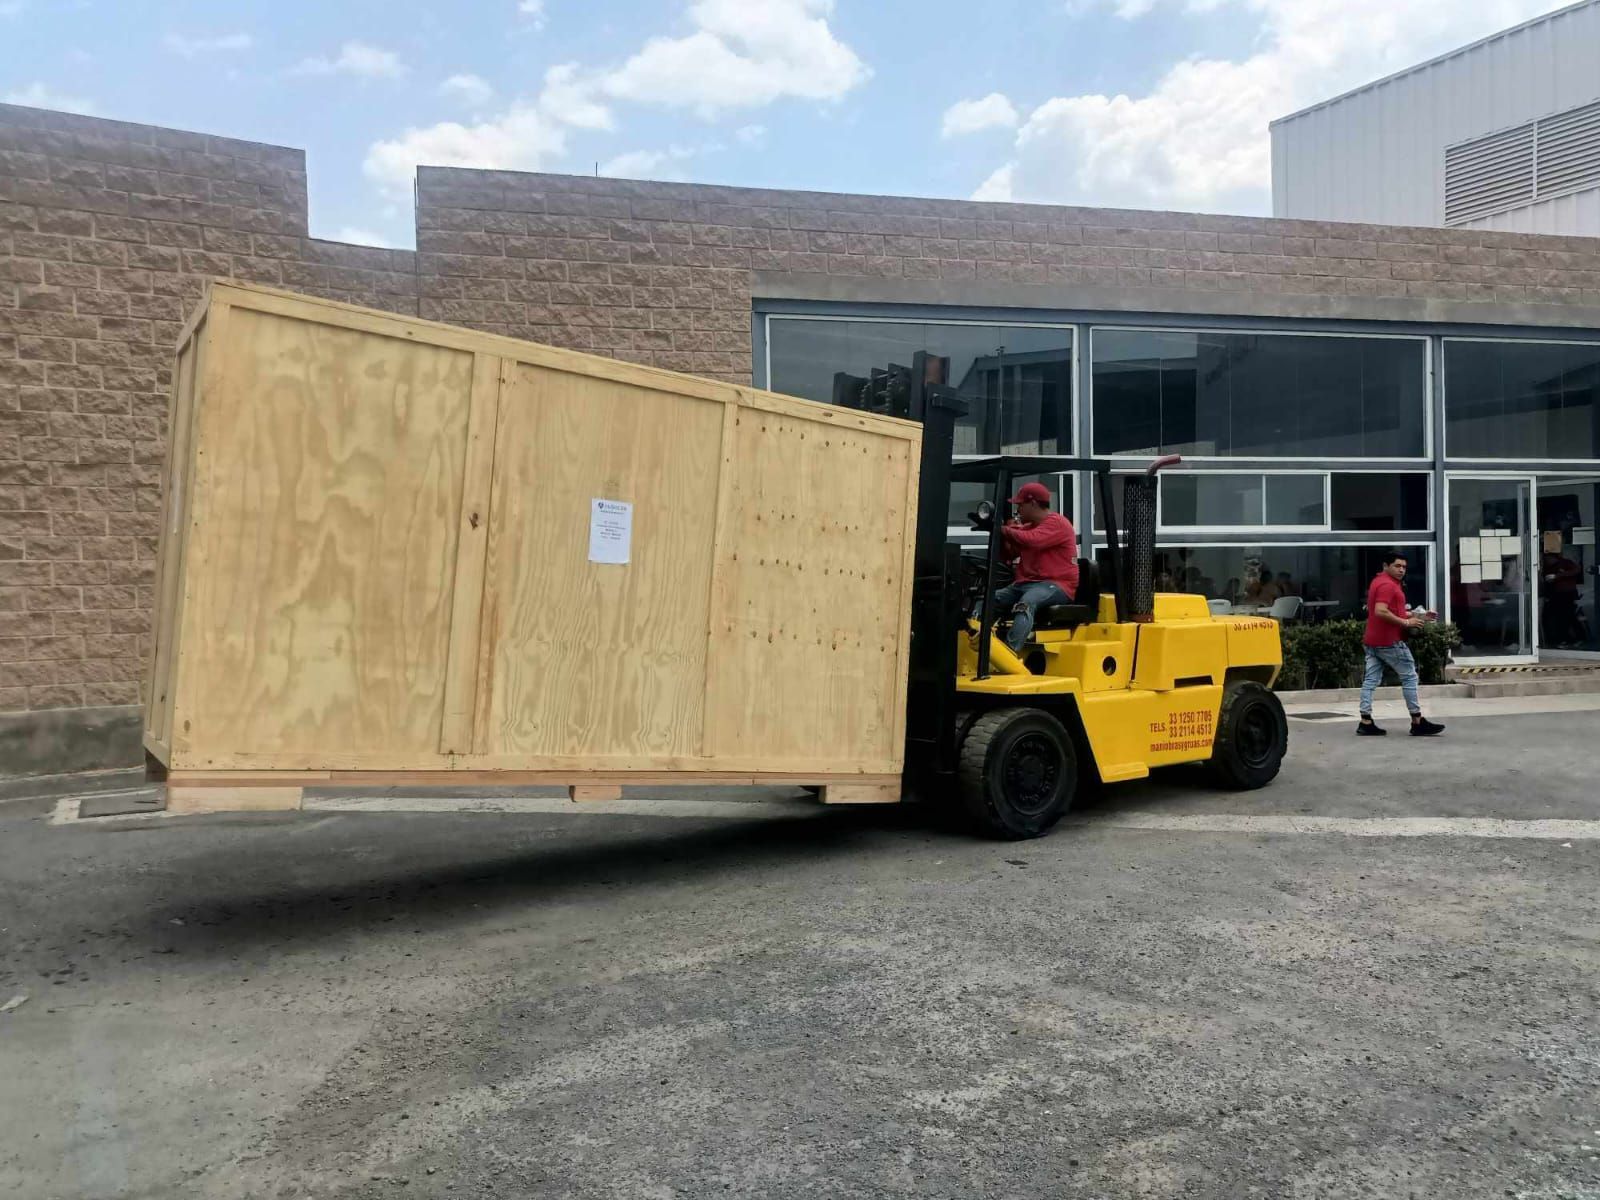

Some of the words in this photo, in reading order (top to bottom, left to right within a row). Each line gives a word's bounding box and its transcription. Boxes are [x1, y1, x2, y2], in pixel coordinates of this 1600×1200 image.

[1169, 712, 1177, 724] 33
[1179, 711, 1194, 723] 1250
[1169, 726, 1177, 738] 33
[1179, 725, 1194, 737] 2114
[1197, 724, 1211, 735] 4513
